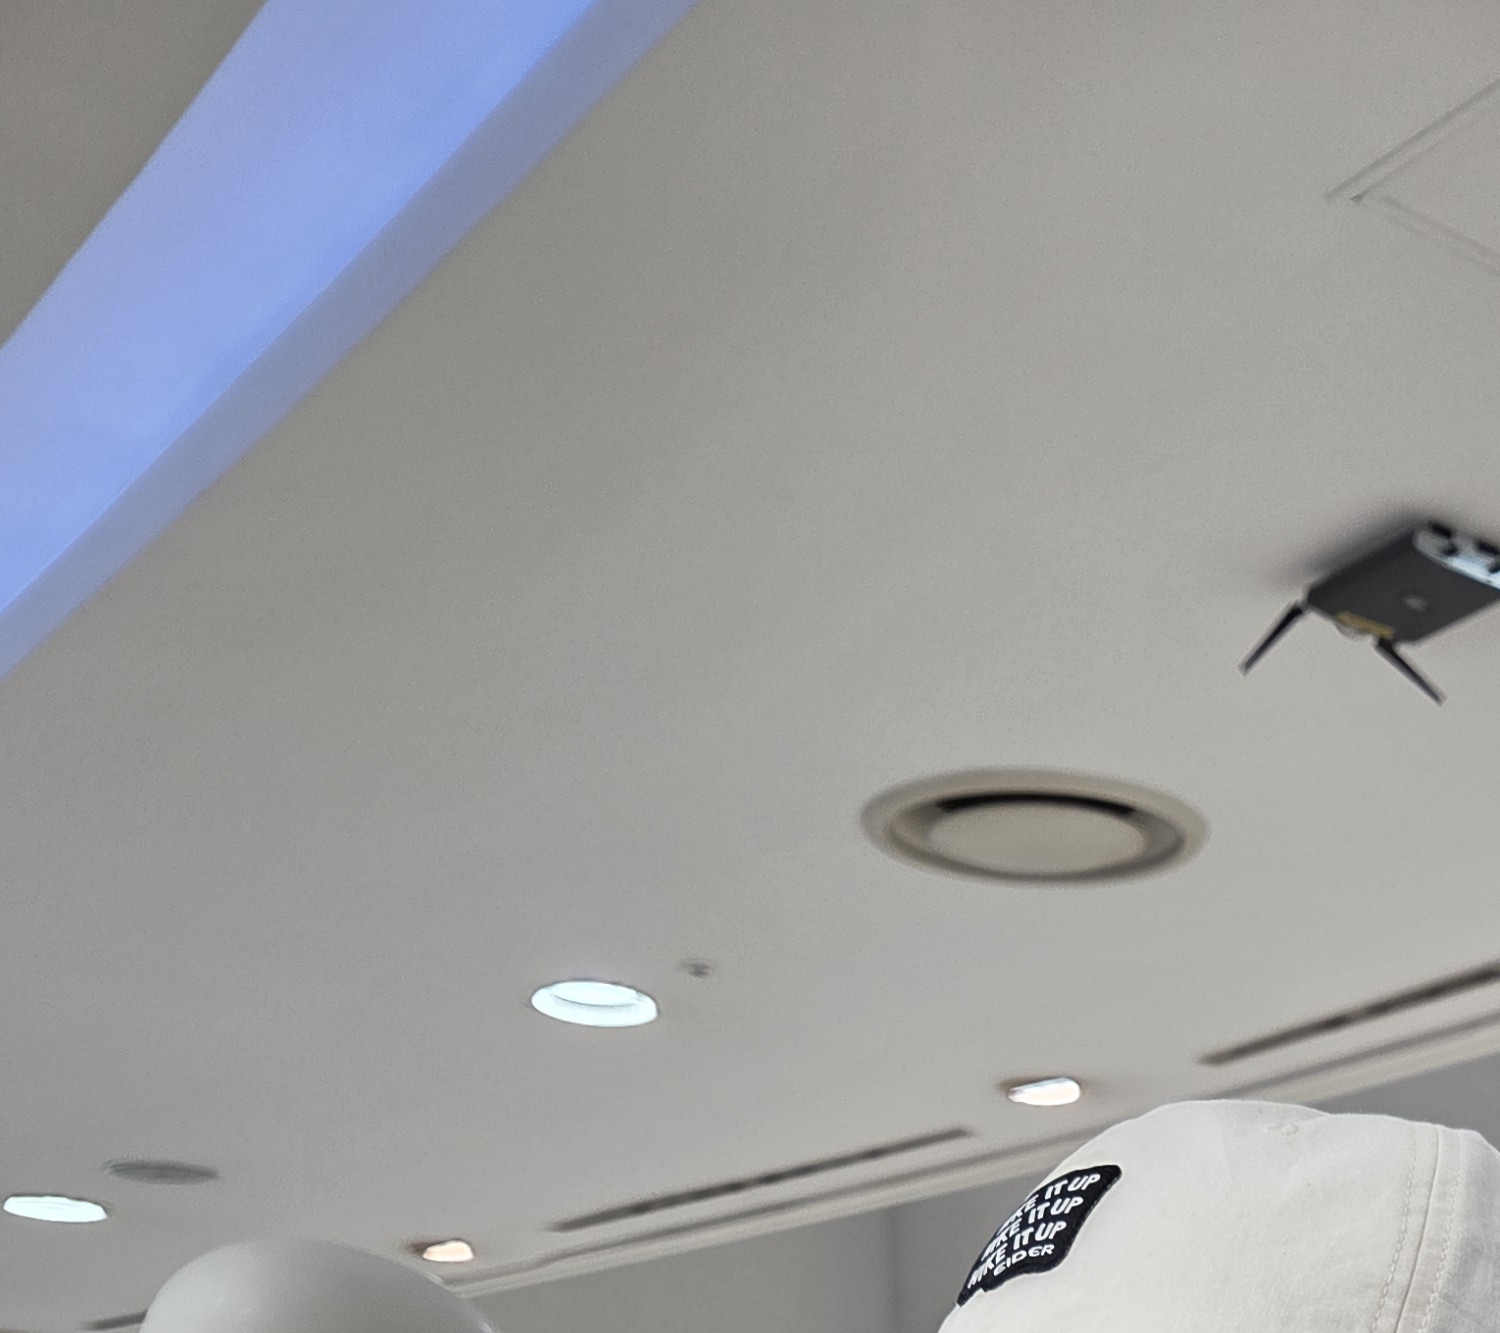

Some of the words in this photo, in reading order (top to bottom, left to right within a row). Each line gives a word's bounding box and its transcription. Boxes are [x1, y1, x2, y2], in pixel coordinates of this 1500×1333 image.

[1044, 1179, 1068, 1200] IT
[1067, 1173, 1101, 1192] UP
[1028, 1201, 1050, 1224] IT
[1050, 1196, 1084, 1215] UP
[1013, 1227, 1034, 1250] IT
[1035, 1221, 1067, 1241] UP
[993, 1244, 1055, 1276] EIDER
